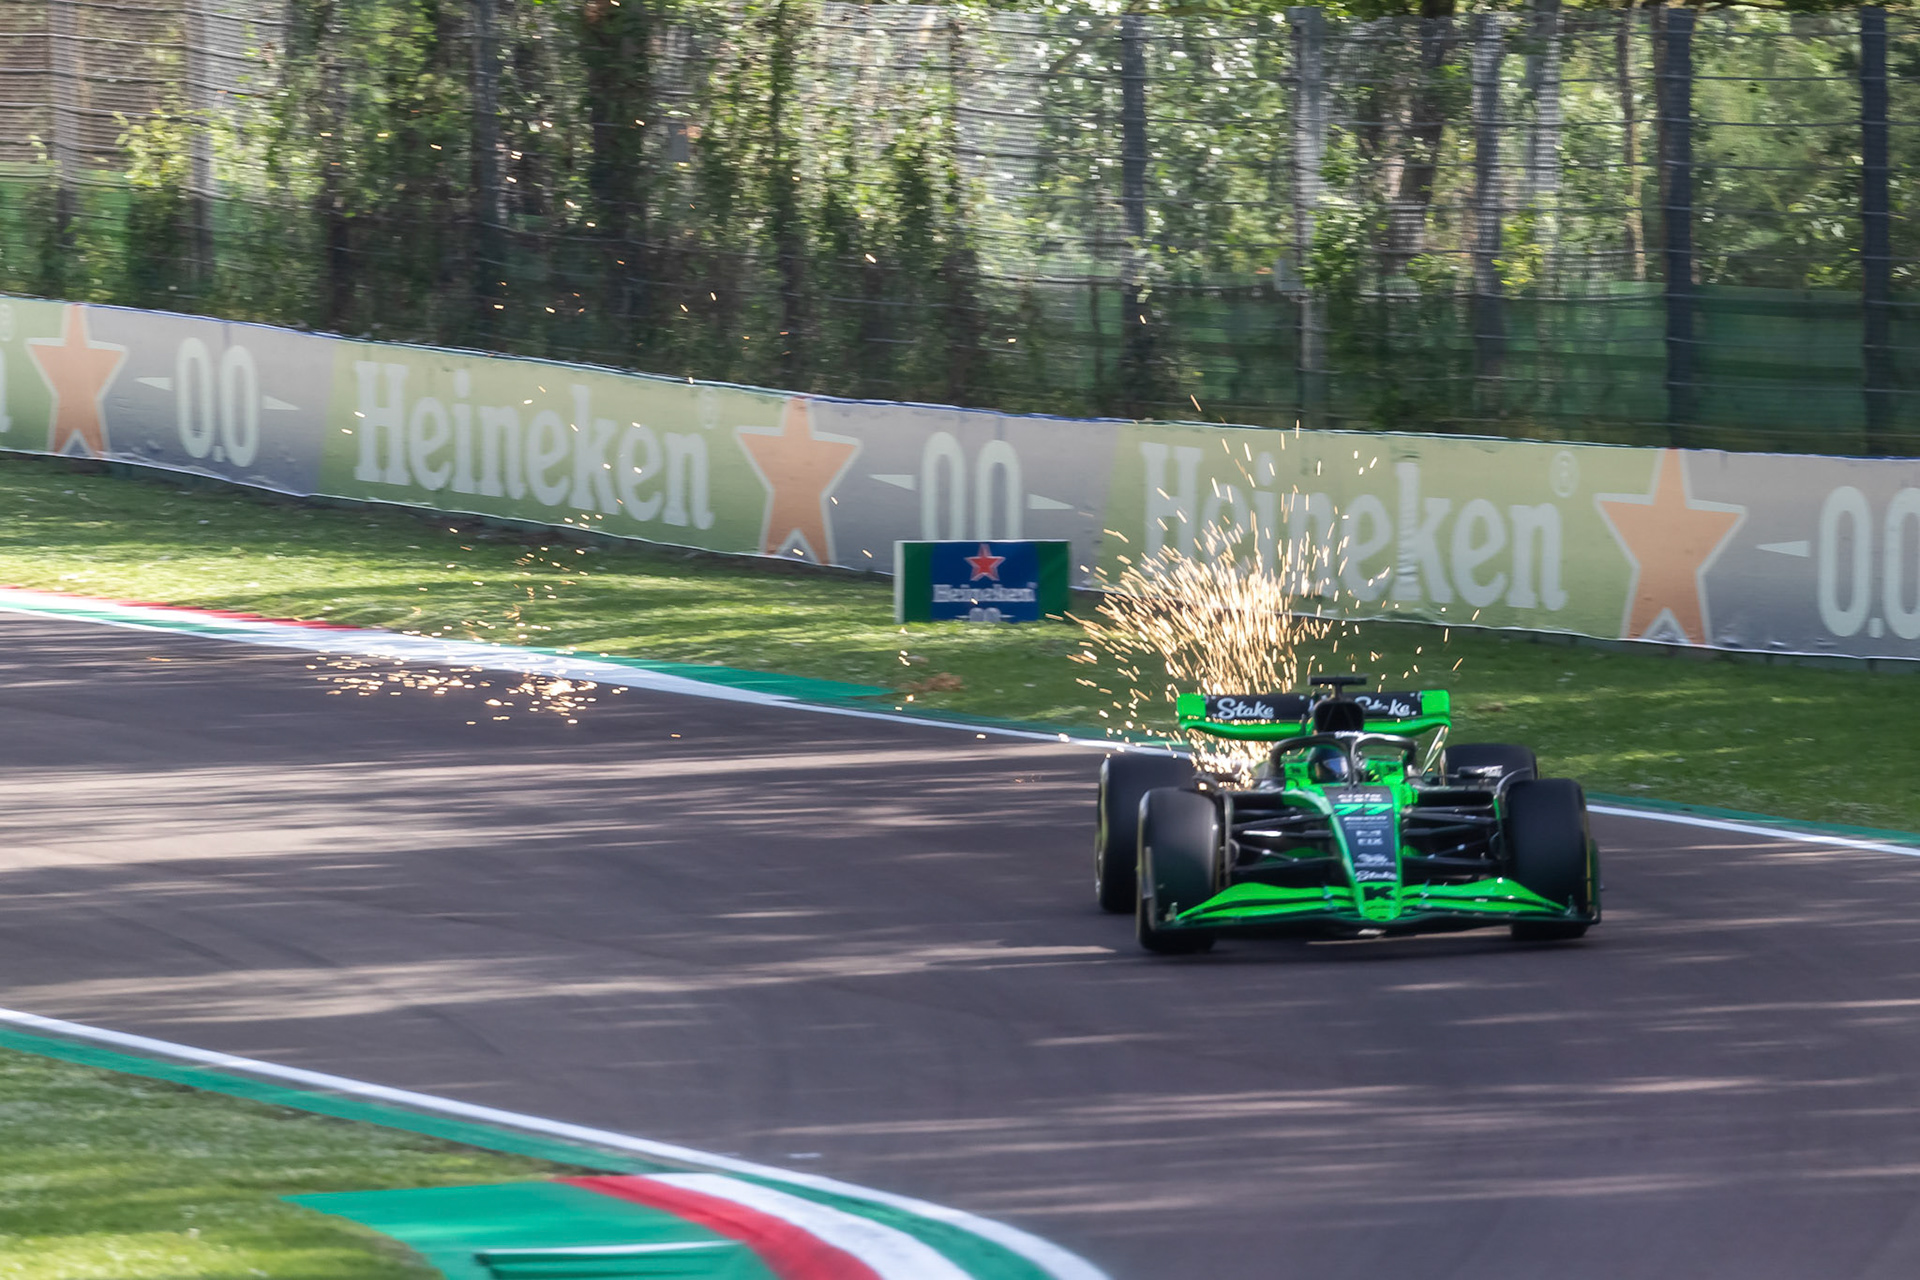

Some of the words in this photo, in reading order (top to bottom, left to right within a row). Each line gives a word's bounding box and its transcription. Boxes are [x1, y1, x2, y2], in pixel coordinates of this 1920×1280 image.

[175, 337, 261, 468] 0.0
[353, 360, 716, 530] Heineken
[920, 431, 1024, 540] 00
[1216, 697, 1275, 721] Stake
[1334, 803, 1393, 815] 77
